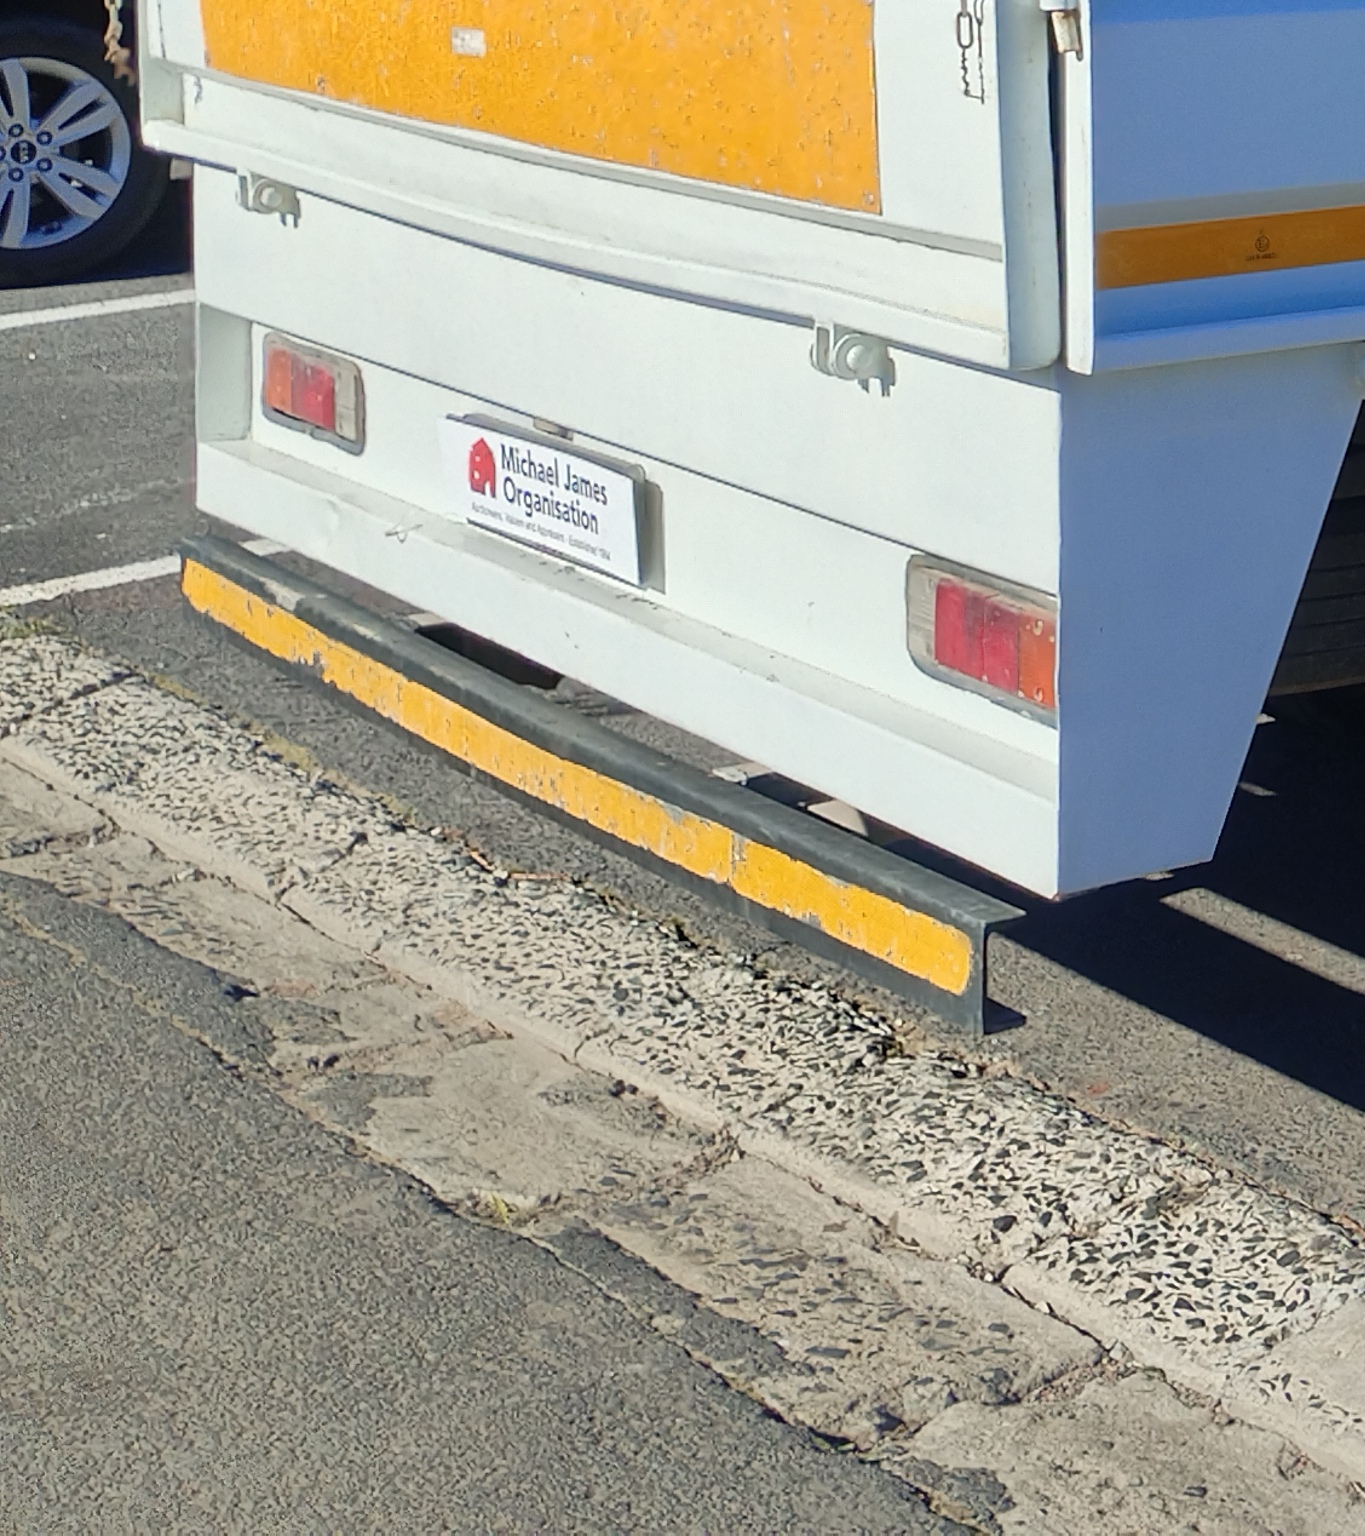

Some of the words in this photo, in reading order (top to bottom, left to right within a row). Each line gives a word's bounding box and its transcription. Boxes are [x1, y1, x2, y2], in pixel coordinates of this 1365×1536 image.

[500, 443, 559, 489] Michael
[563, 463, 608, 506] James
[503, 476, 599, 535] Organisation
